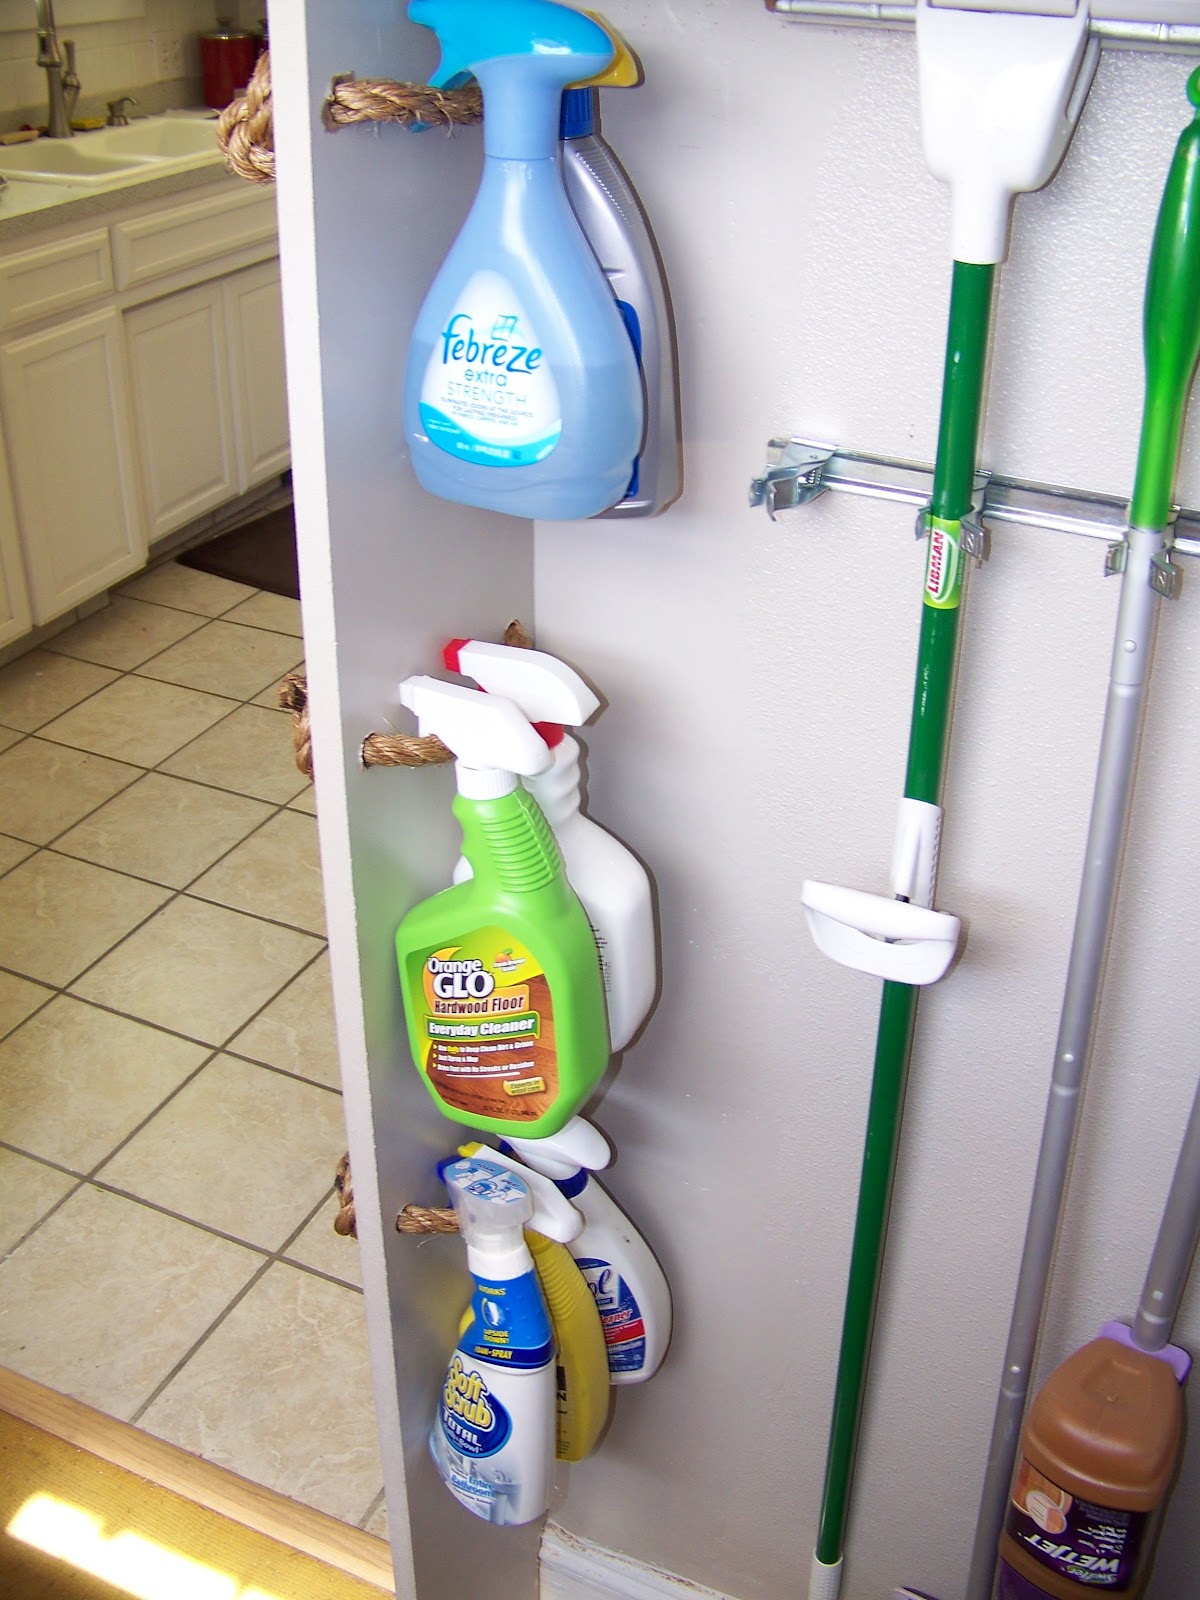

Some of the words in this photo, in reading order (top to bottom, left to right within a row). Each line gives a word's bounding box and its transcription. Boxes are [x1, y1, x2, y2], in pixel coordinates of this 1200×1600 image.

[441, 313, 543, 375] febreze
[465, 369, 508, 388] extra
[447, 381, 529, 408] STRENGTH
[928, 531, 944, 593] LIBMAN
[427, 957, 482, 974] Orange
[433, 970, 495, 999] GLO
[434, 1000, 488, 1014] Hardwood
[492, 996, 524, 1011] Floor
[429, 1022, 479, 1037] Everyday
[480, 1018, 535, 1036] Cleaner
[448, 1357, 487, 1402] Soft
[444, 1378, 492, 1428] Scrub
[443, 1406, 482, 1447] TOTAL
[451, 1474, 495, 1498] Bathroom
[469, 1474, 495, 1490] Entire
[1024, 1533, 1120, 1573] WETJET
